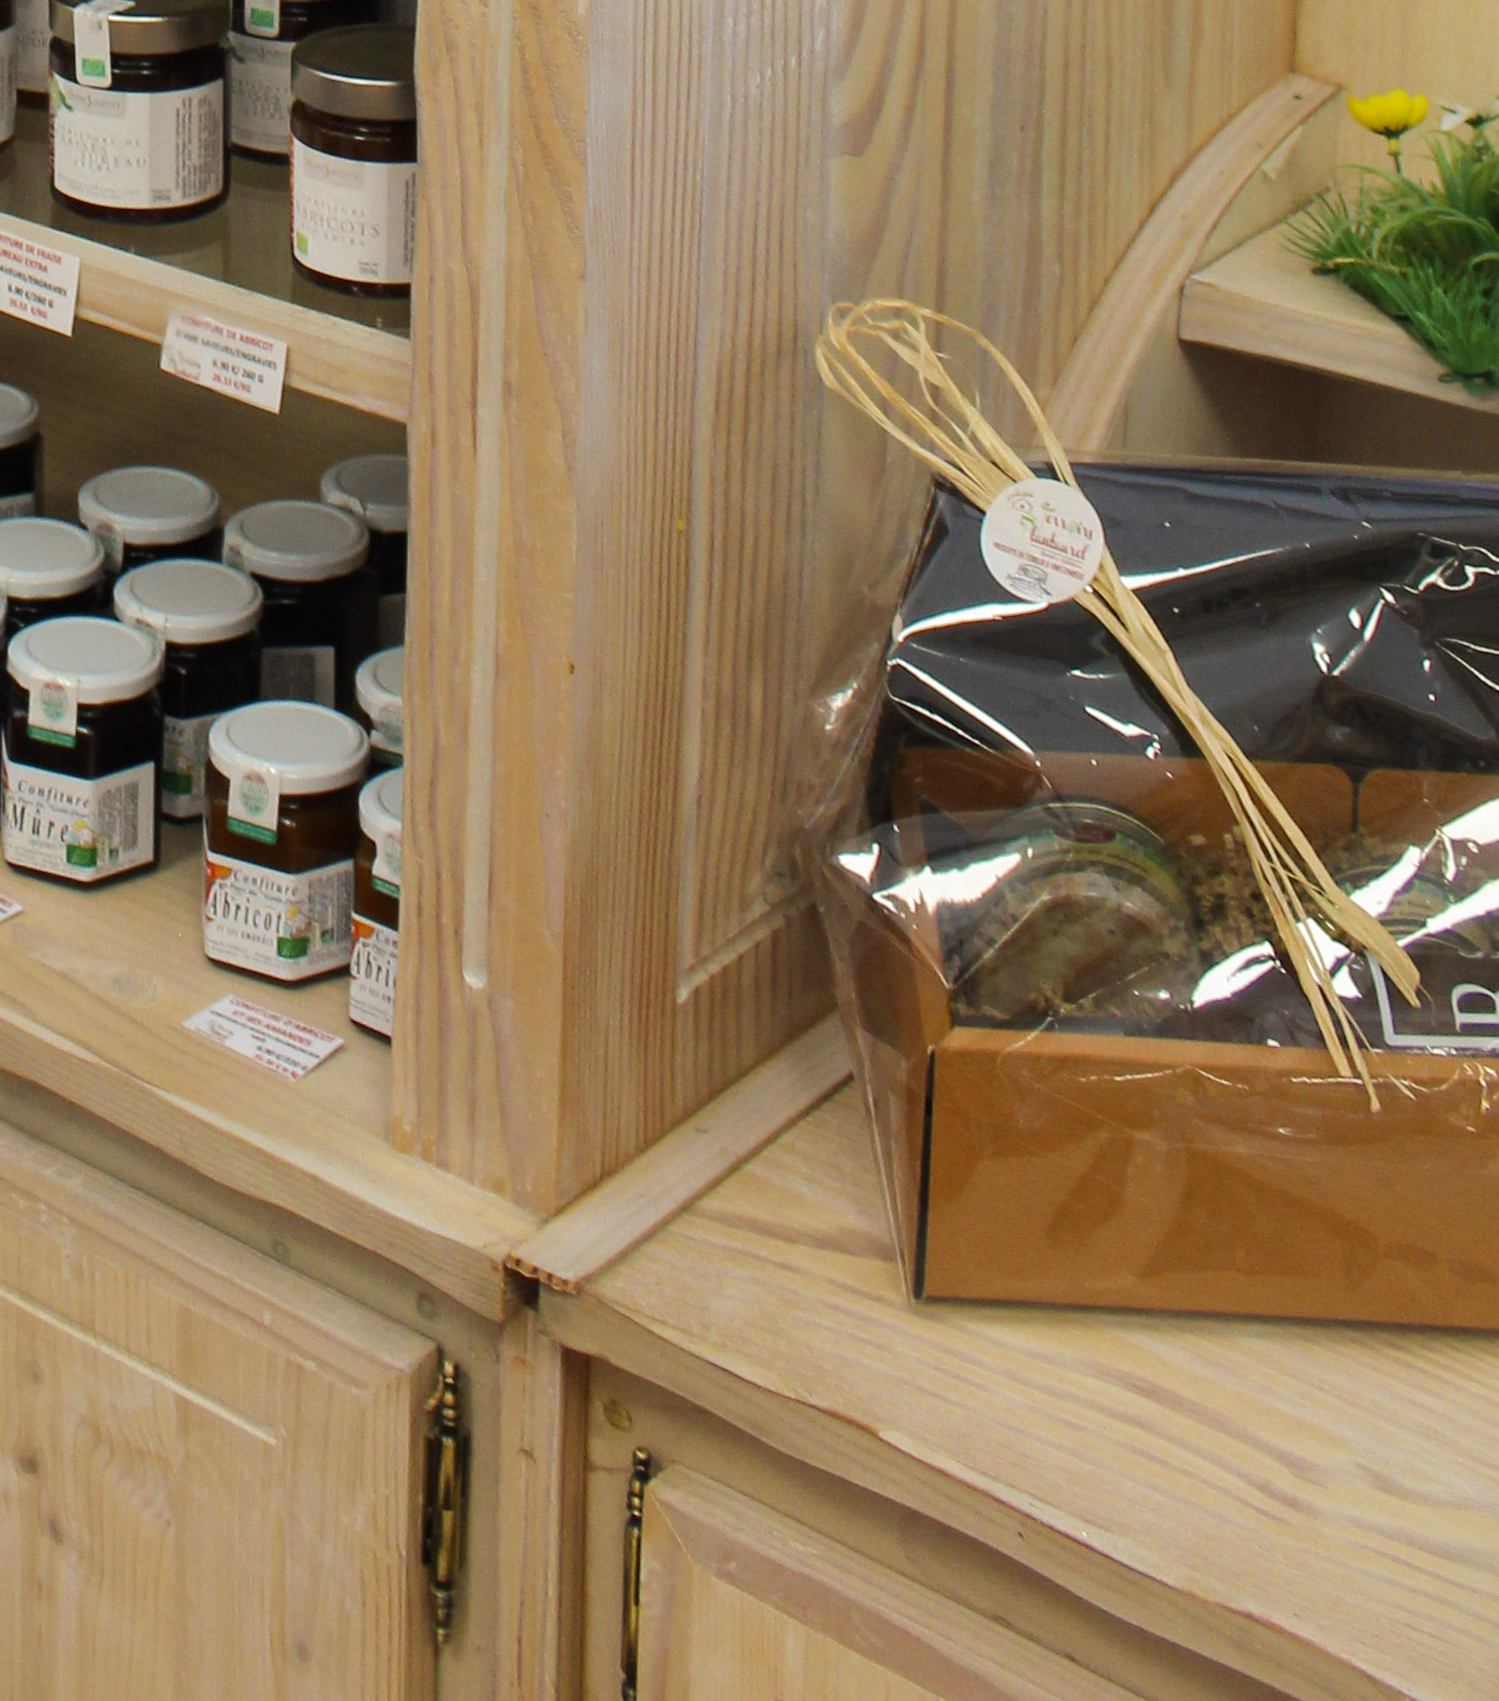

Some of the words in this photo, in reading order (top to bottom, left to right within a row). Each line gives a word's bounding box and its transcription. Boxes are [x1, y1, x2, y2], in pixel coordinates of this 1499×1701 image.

[17, 779, 89, 809] Confiture
[10, 803, 69, 843] Mûre
[233, 870, 299, 896] Confiture
[207, 886, 282, 934] Abricot
